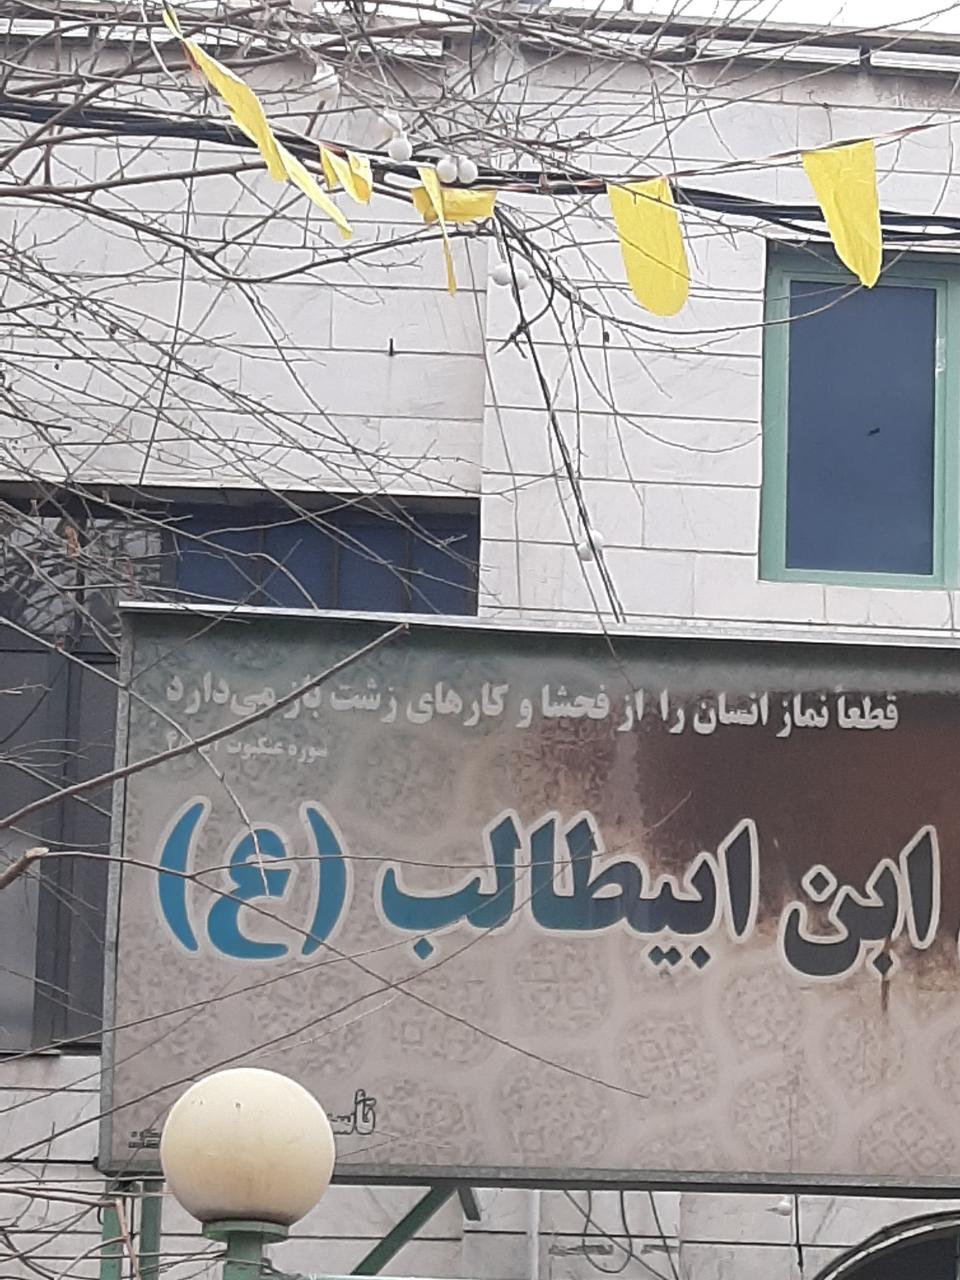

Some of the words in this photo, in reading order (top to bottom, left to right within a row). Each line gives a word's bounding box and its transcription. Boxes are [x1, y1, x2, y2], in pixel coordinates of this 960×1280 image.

[329, 676, 398, 724] زشت
[405, 680, 510, 727] کارهای
[515, 696, 534, 729] و
[541, 683, 611, 721] فحشا
[617, 687, 645, 732] از
[660, 688, 686, 734] را
[693, 690, 769, 735] انسان
[776, 693, 830, 738] نماز
[152, 795, 355, 963] (ع)
[374, 808, 761, 972] ابیطالب
[776, 822, 943, 982] ابن
